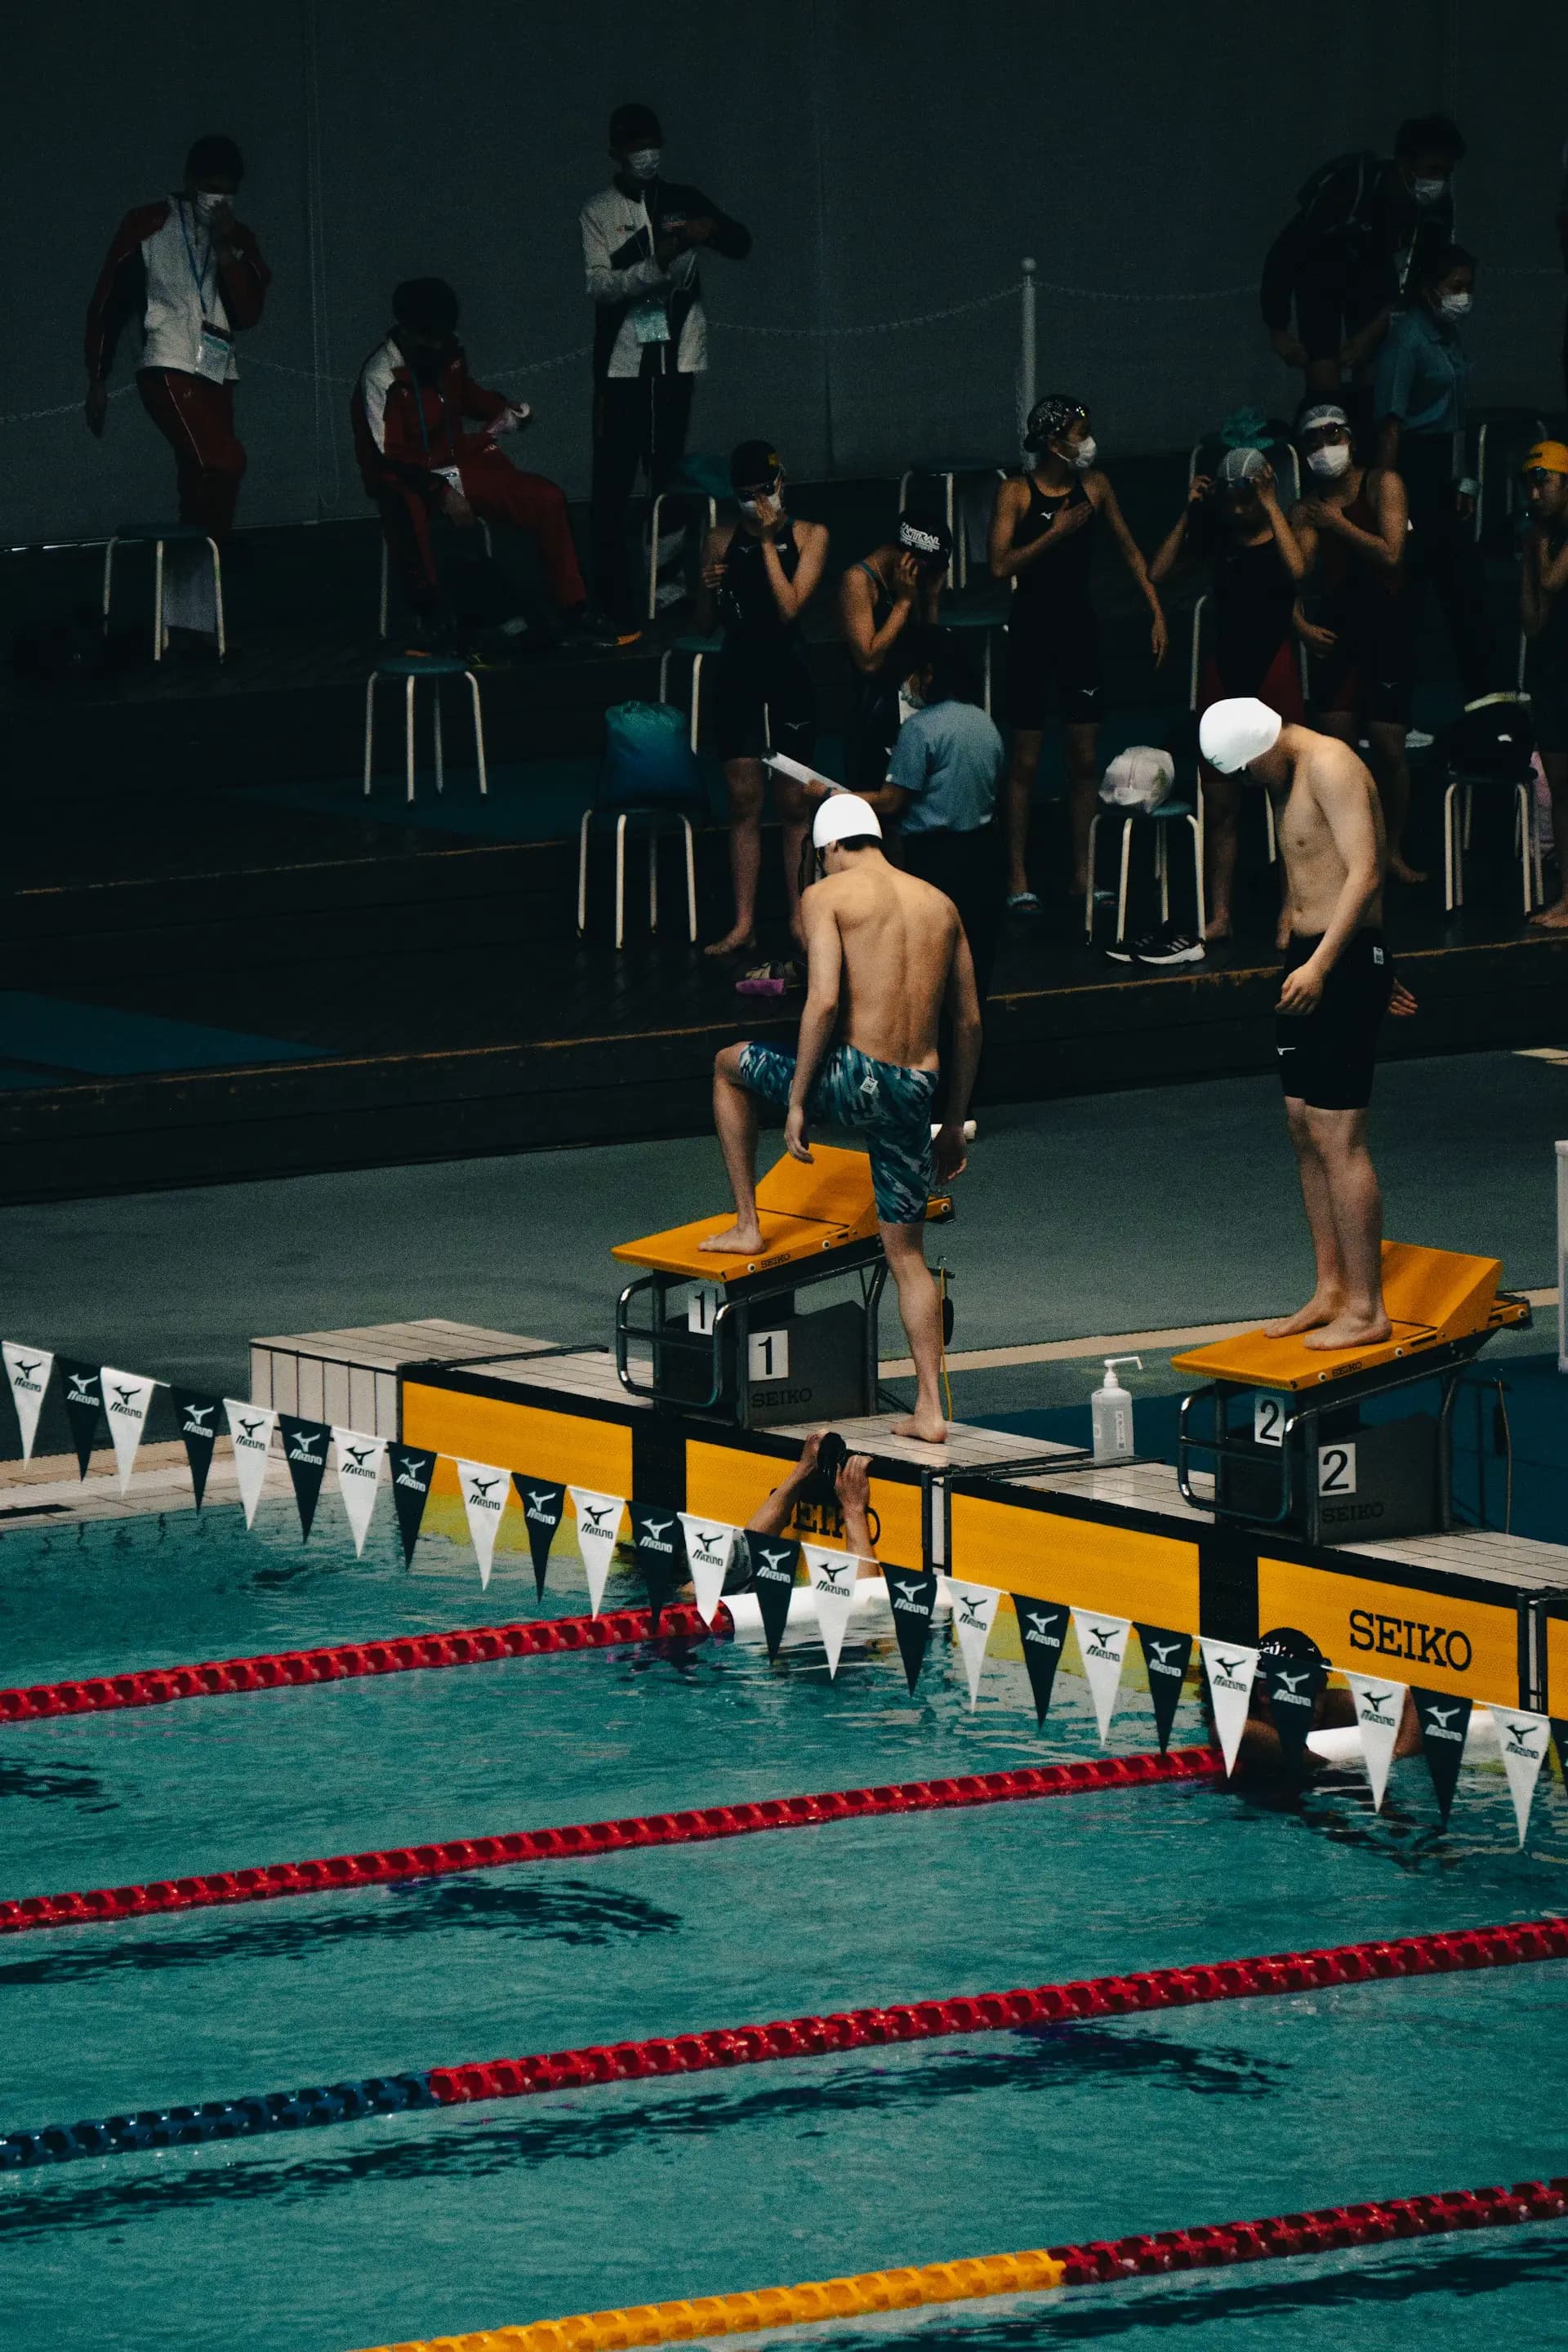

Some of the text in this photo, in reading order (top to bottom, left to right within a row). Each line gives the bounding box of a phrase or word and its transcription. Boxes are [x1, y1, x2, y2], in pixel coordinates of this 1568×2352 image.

[761, 1254, 791, 1268] SEIKO
[695, 1291, 706, 1329] 1
[758, 1336, 773, 1375] 1
[1333, 1361, 1362, 1376] SEIKO
[752, 1388, 813, 1406] SEIKO
[1260, 1400, 1280, 1441] 2
[1322, 1450, 1350, 1491] 2
[1321, 1503, 1385, 1523] SEIKO
[1349, 1609, 1472, 1672] SEIKO
